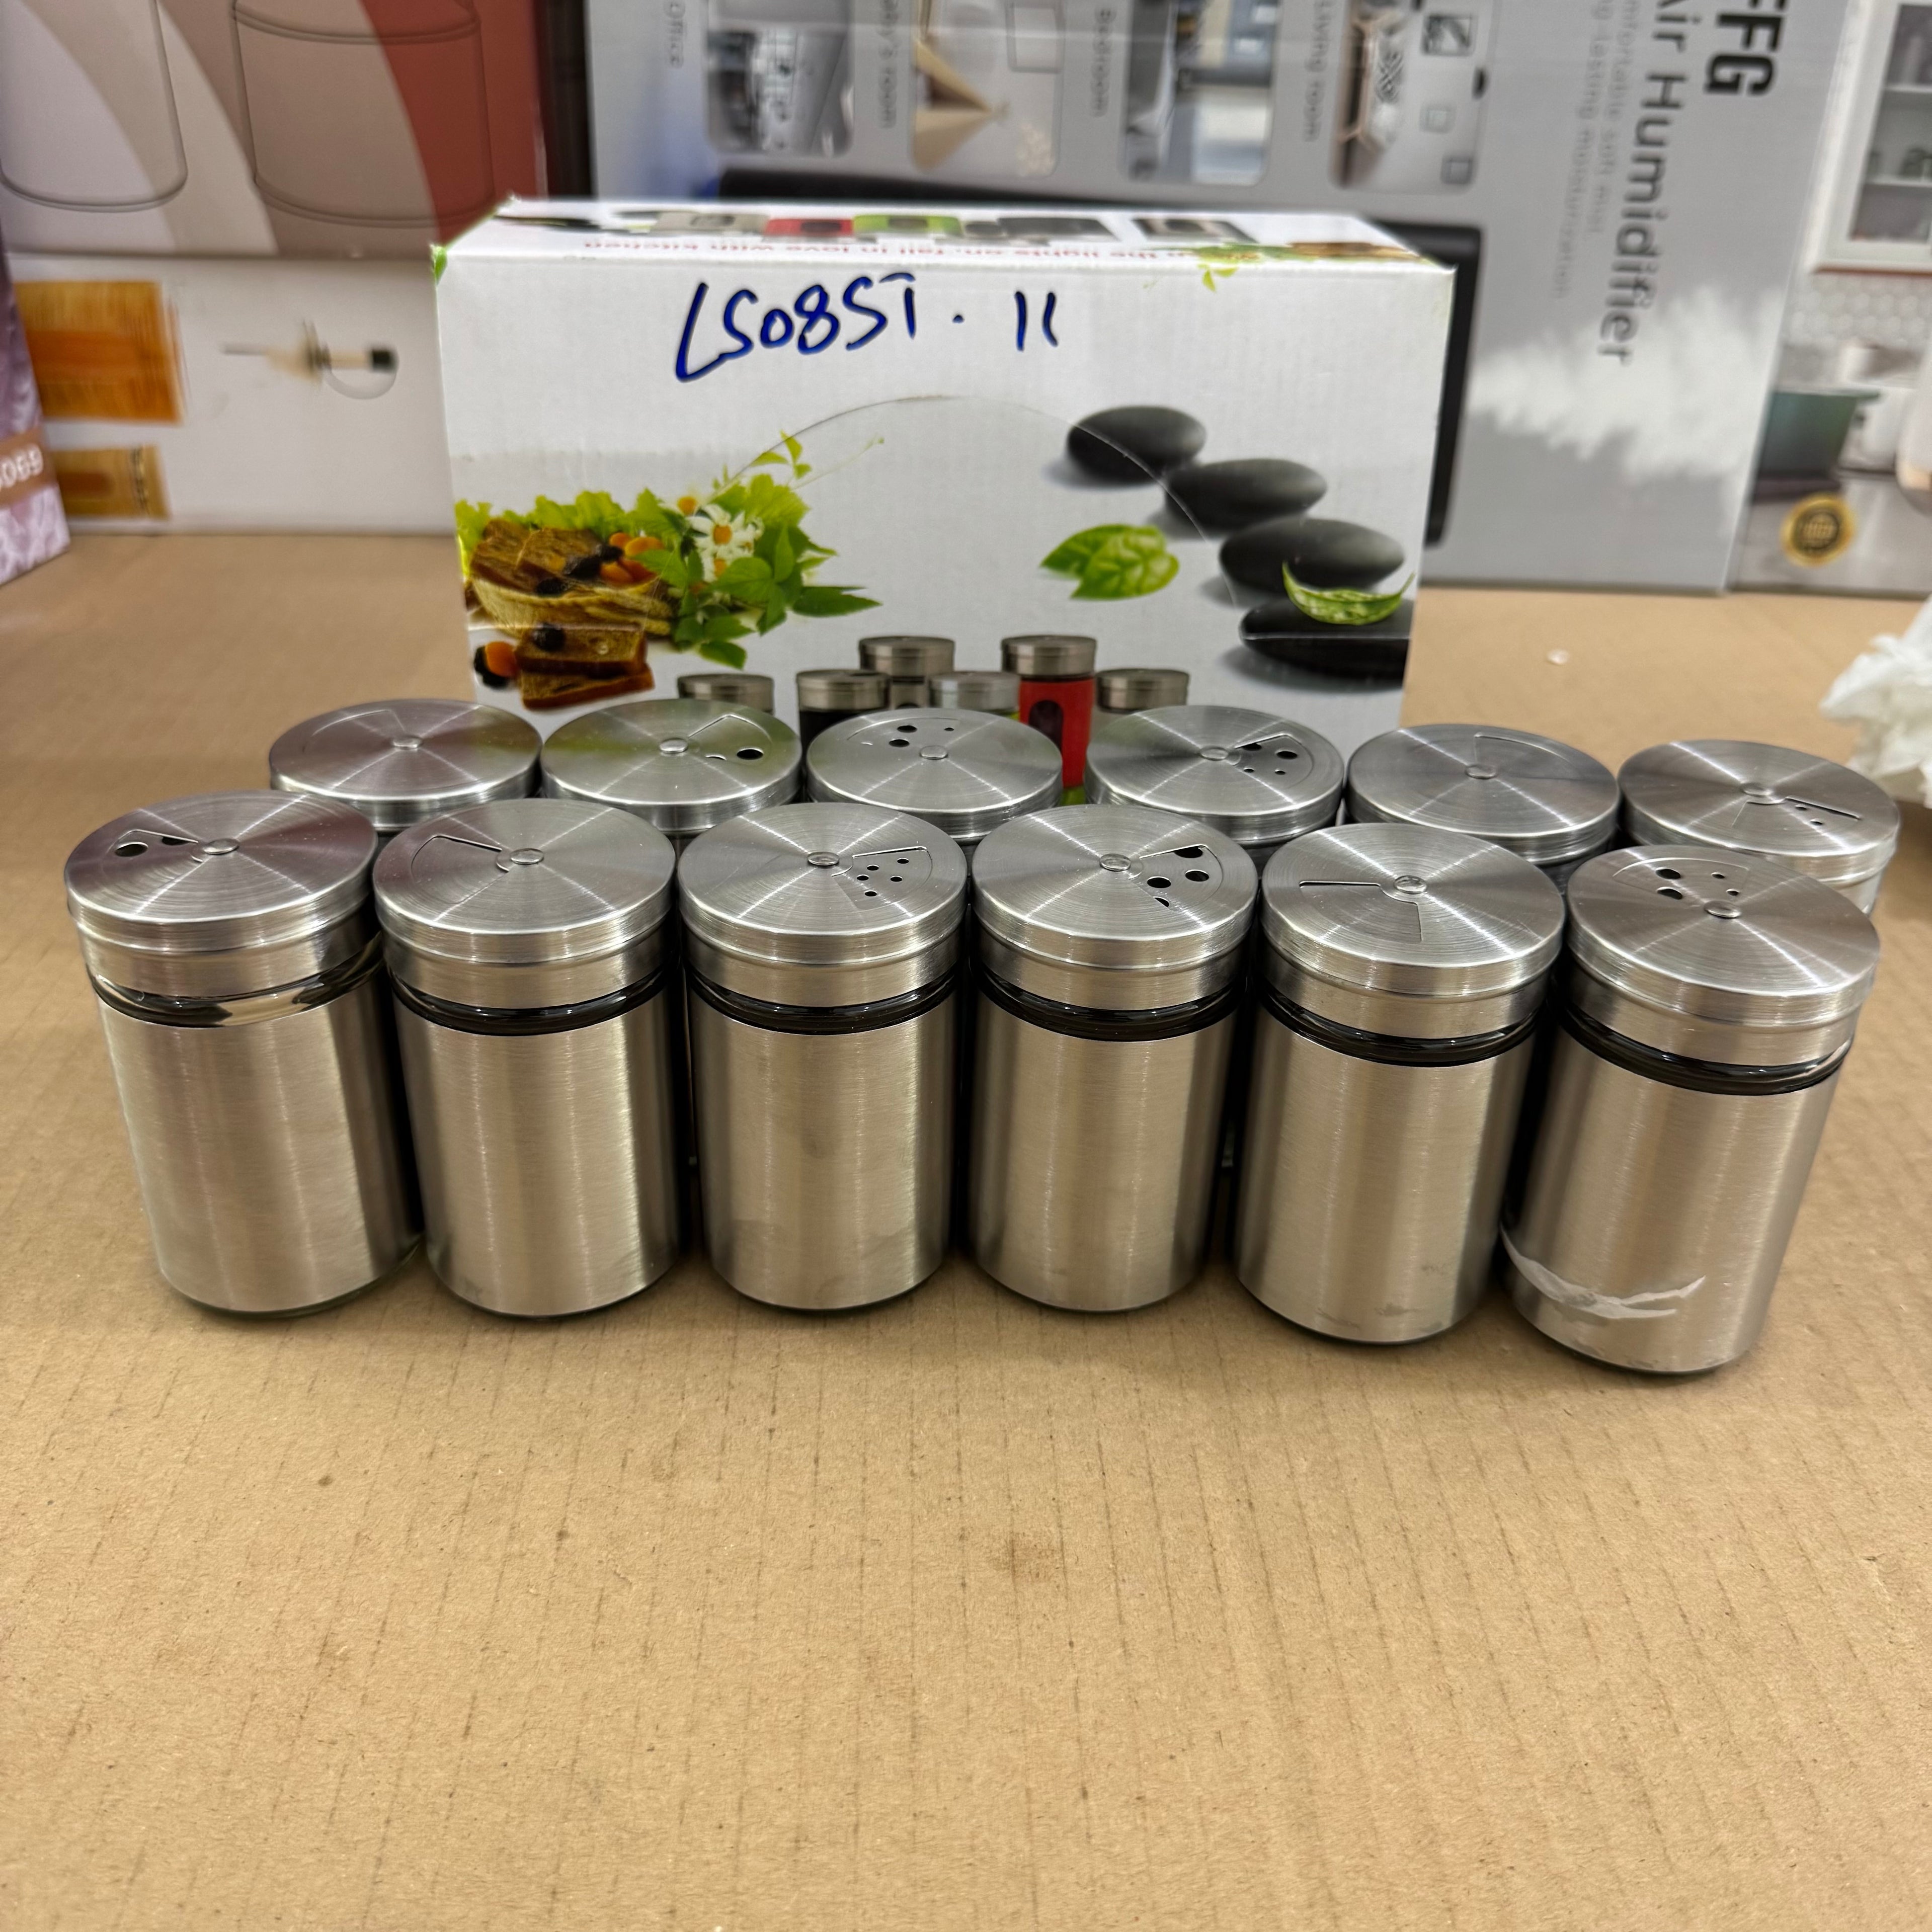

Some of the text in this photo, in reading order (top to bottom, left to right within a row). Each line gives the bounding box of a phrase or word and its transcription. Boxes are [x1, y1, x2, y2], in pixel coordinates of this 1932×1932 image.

[1089, 9, 1117, 118] Bedroom
[1598, 71, 1687, 366] Humidifier
[0, 443, 44, 492] 069
